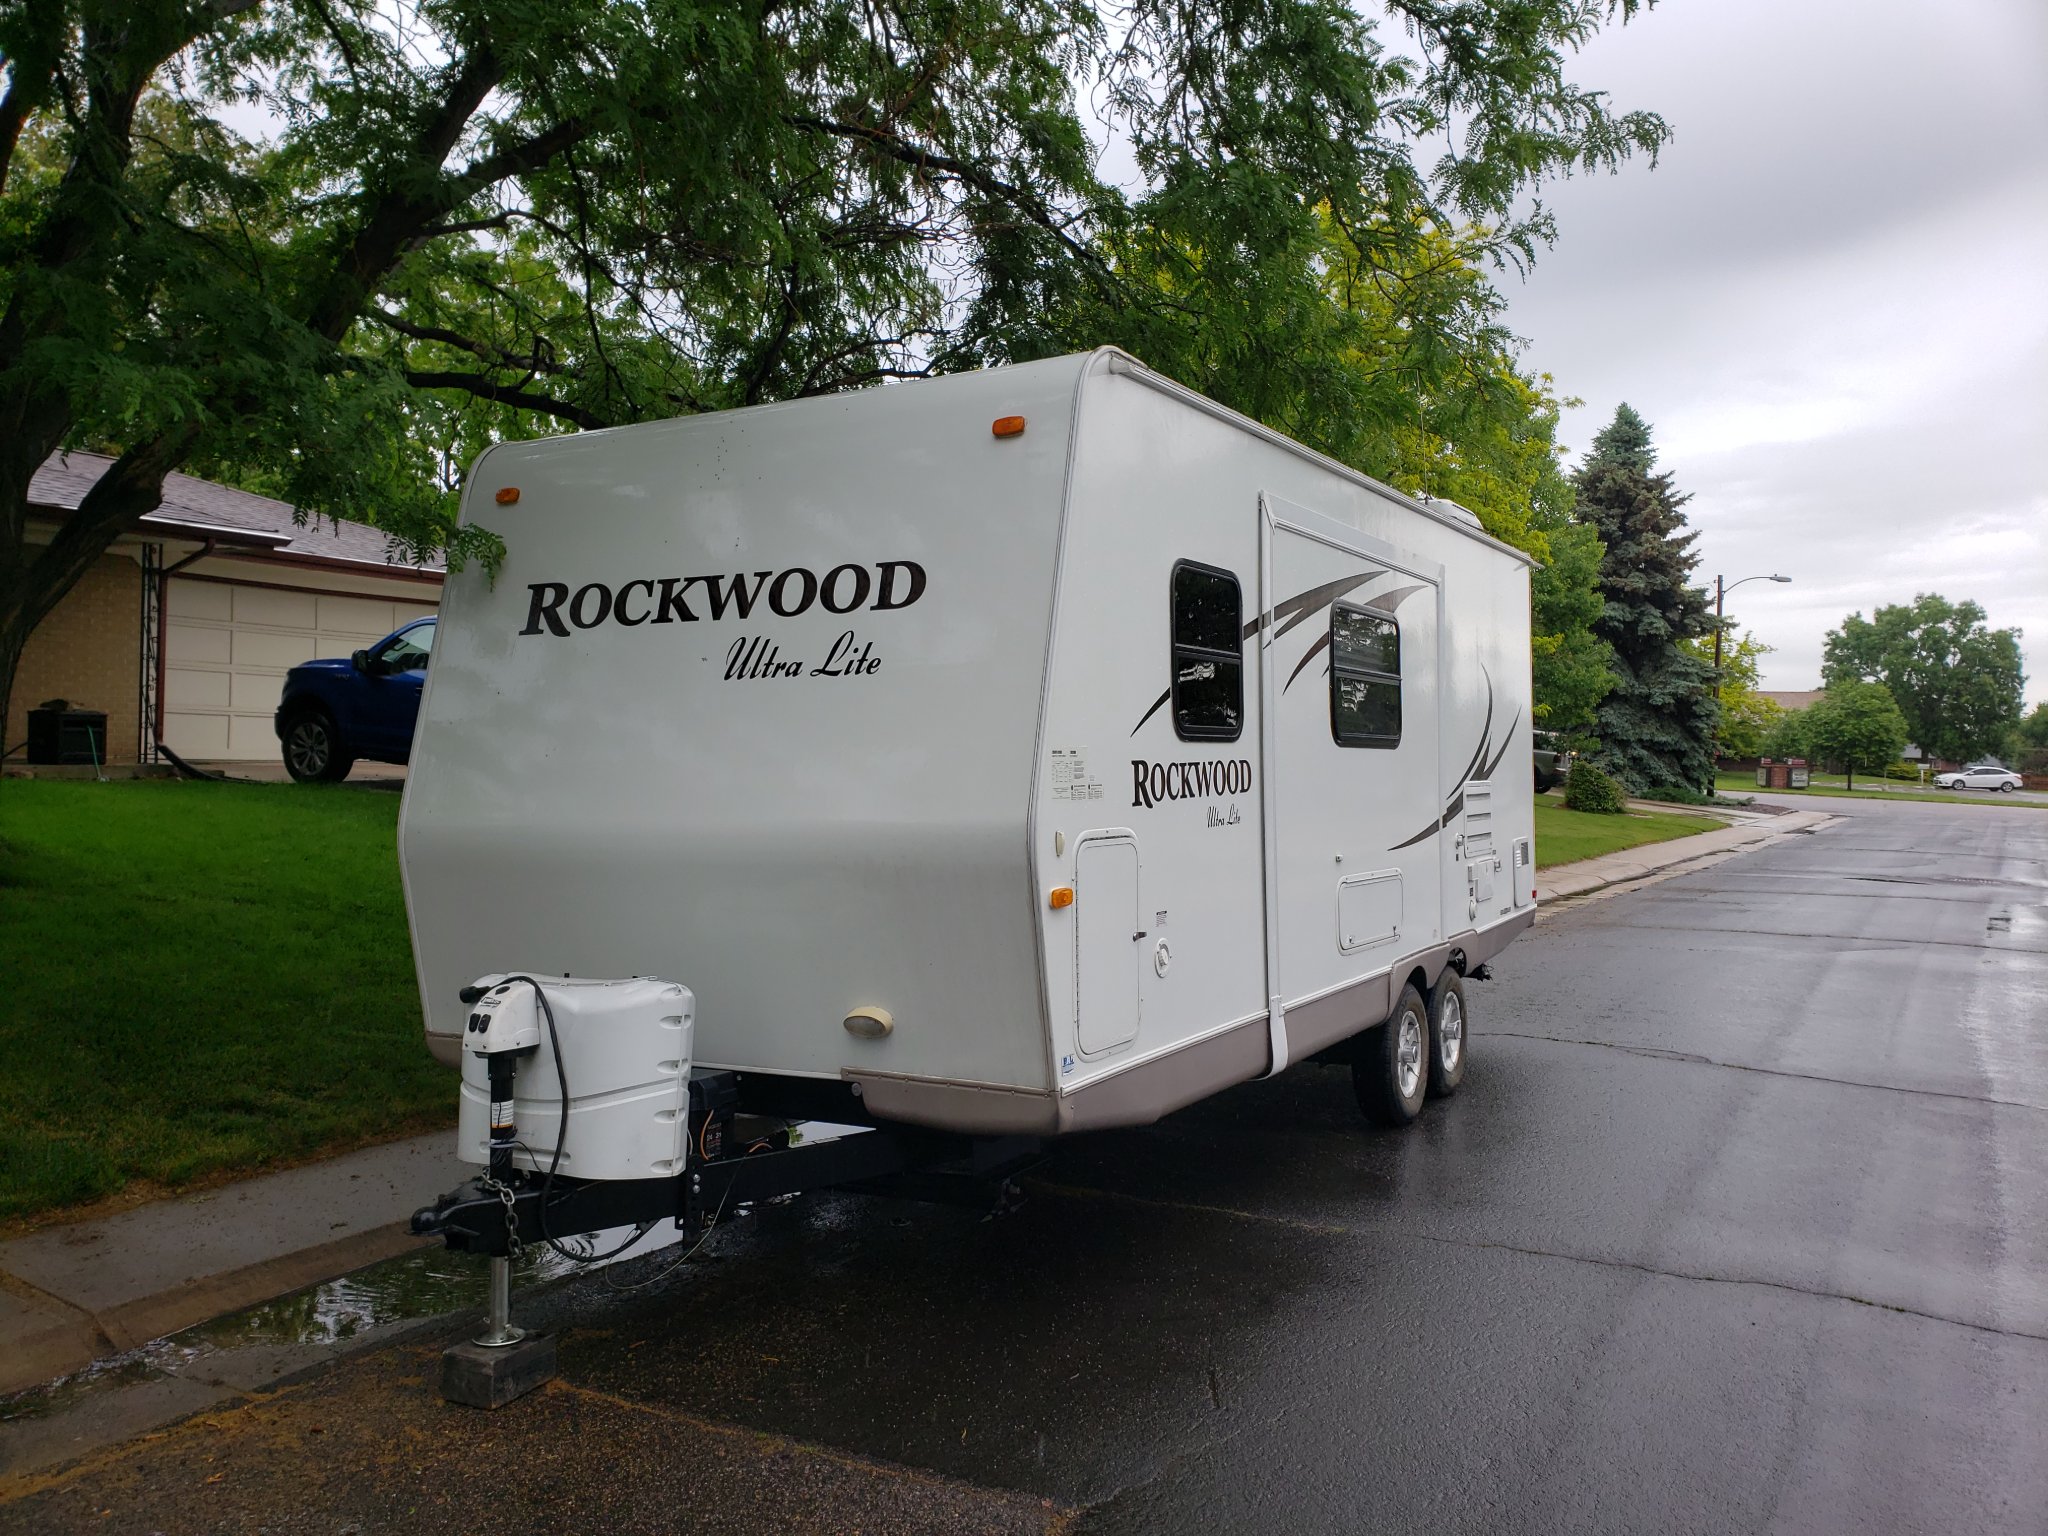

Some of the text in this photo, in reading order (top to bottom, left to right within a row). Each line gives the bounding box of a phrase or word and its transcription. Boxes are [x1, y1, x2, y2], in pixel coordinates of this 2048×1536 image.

[518, 560, 927, 637] ROCKWOOD
[724, 630, 881, 681] Ultra Lite
[1131, 759, 1252, 809] ROCKWOOD
[1207, 805, 1224, 828] Ultra
